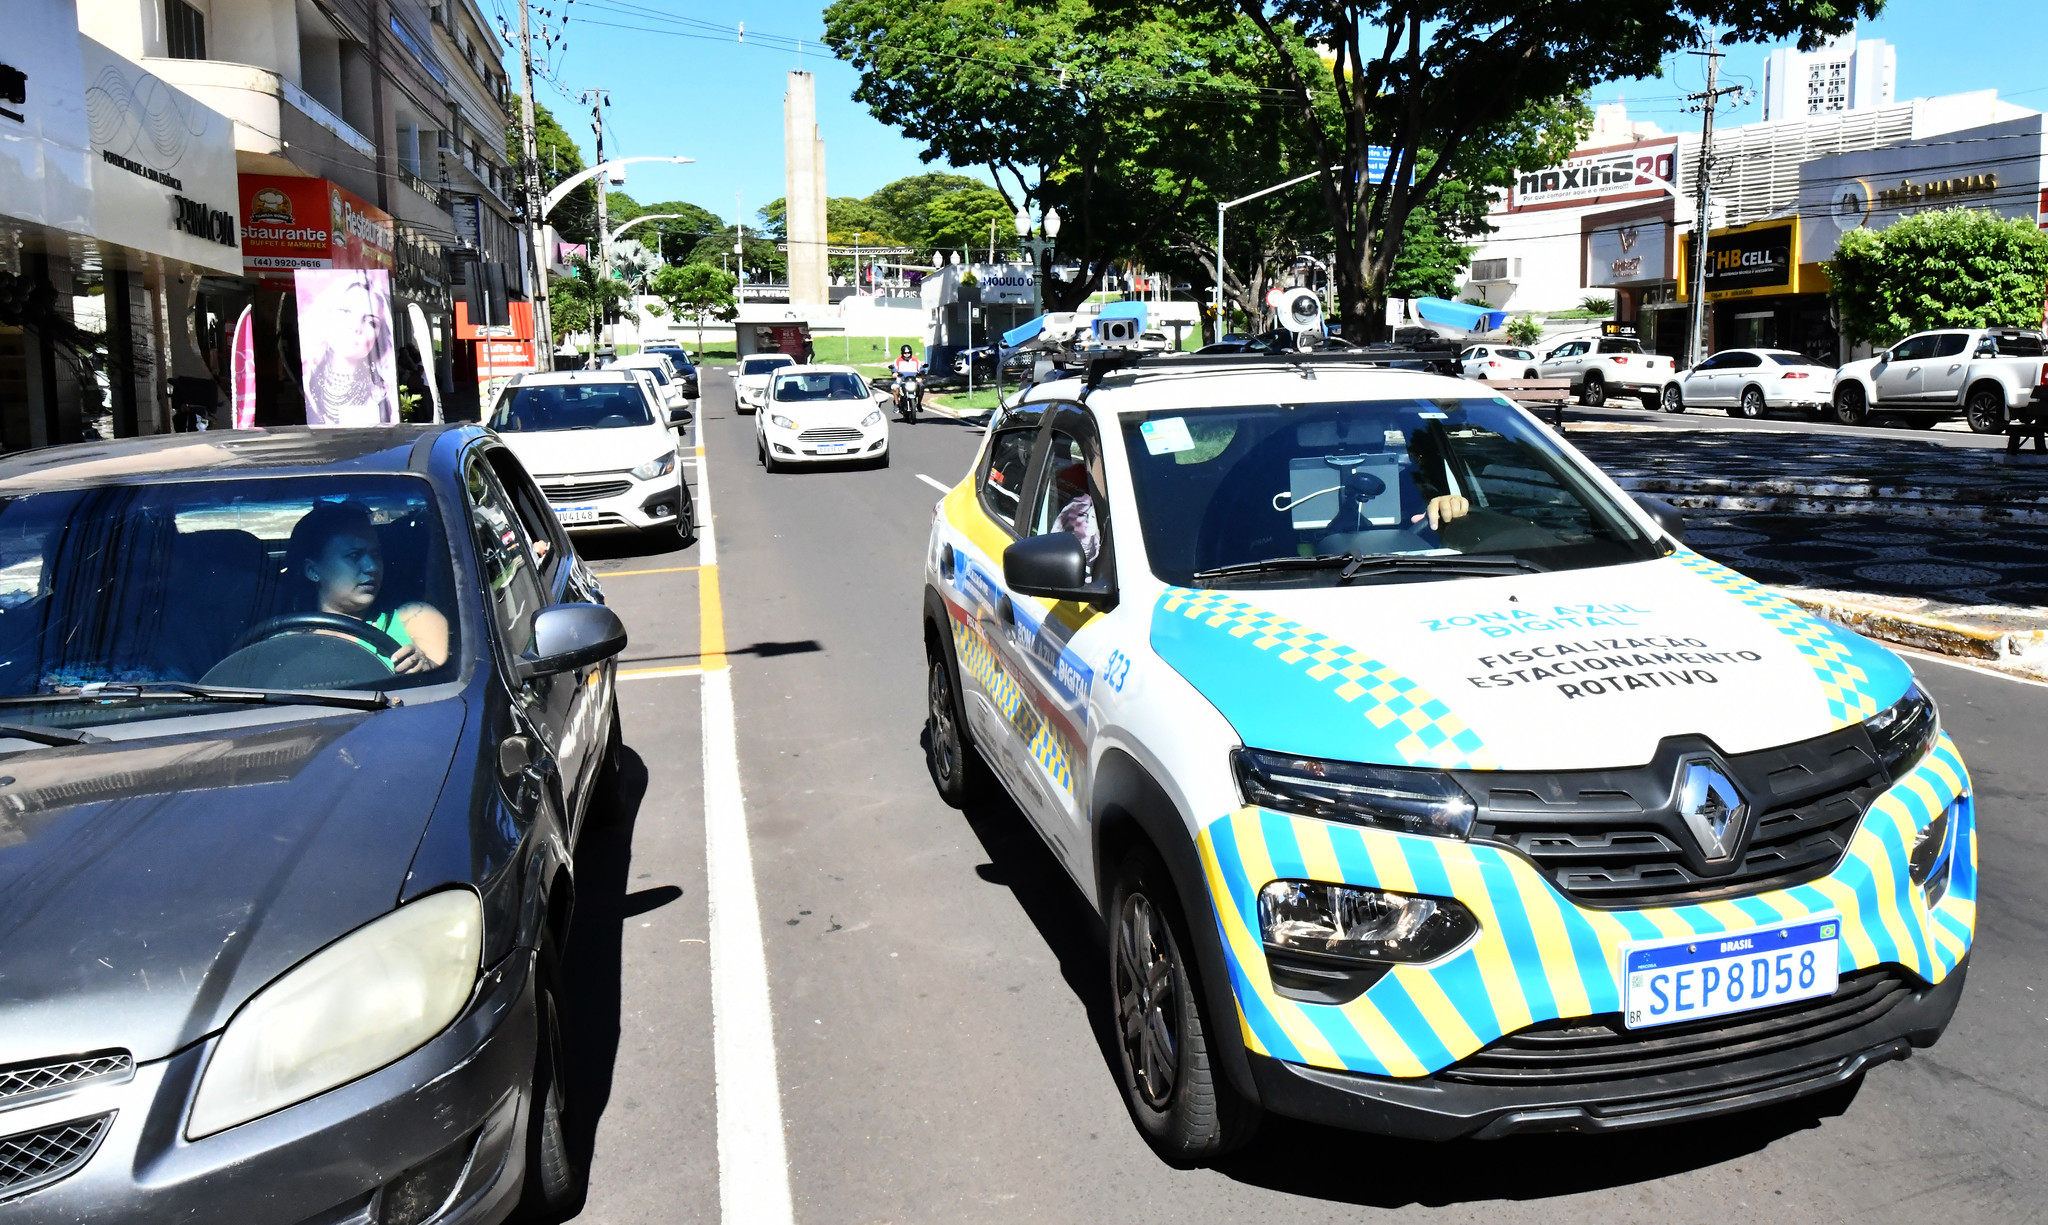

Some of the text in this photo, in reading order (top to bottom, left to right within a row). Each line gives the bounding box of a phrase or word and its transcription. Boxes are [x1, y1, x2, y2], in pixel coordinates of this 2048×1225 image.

[1635, 153, 1674, 186] 20
[1925, 173, 1997, 201] MARIAS
[241, 226, 327, 241] staurante
[288, 241, 327, 249] MARMITEX
[254, 257, 321, 268] (44) 9920-9616
[983, 274, 1025, 287] MÓDULO
[1419, 603, 1652, 632] ZONA AZUL
[1479, 616, 1640, 638] DIGITAL
[1478, 635, 1708, 668] FISCALIZAÇÃO
[1467, 650, 1763, 688] ESTACIONAMENTO
[1557, 669, 1719, 699] ROTATIVO
[1720, 939, 1754, 953] BRASIL
[1649, 950, 1816, 1015] SEP8D58
[1629, 1010, 1642, 1024] BR
